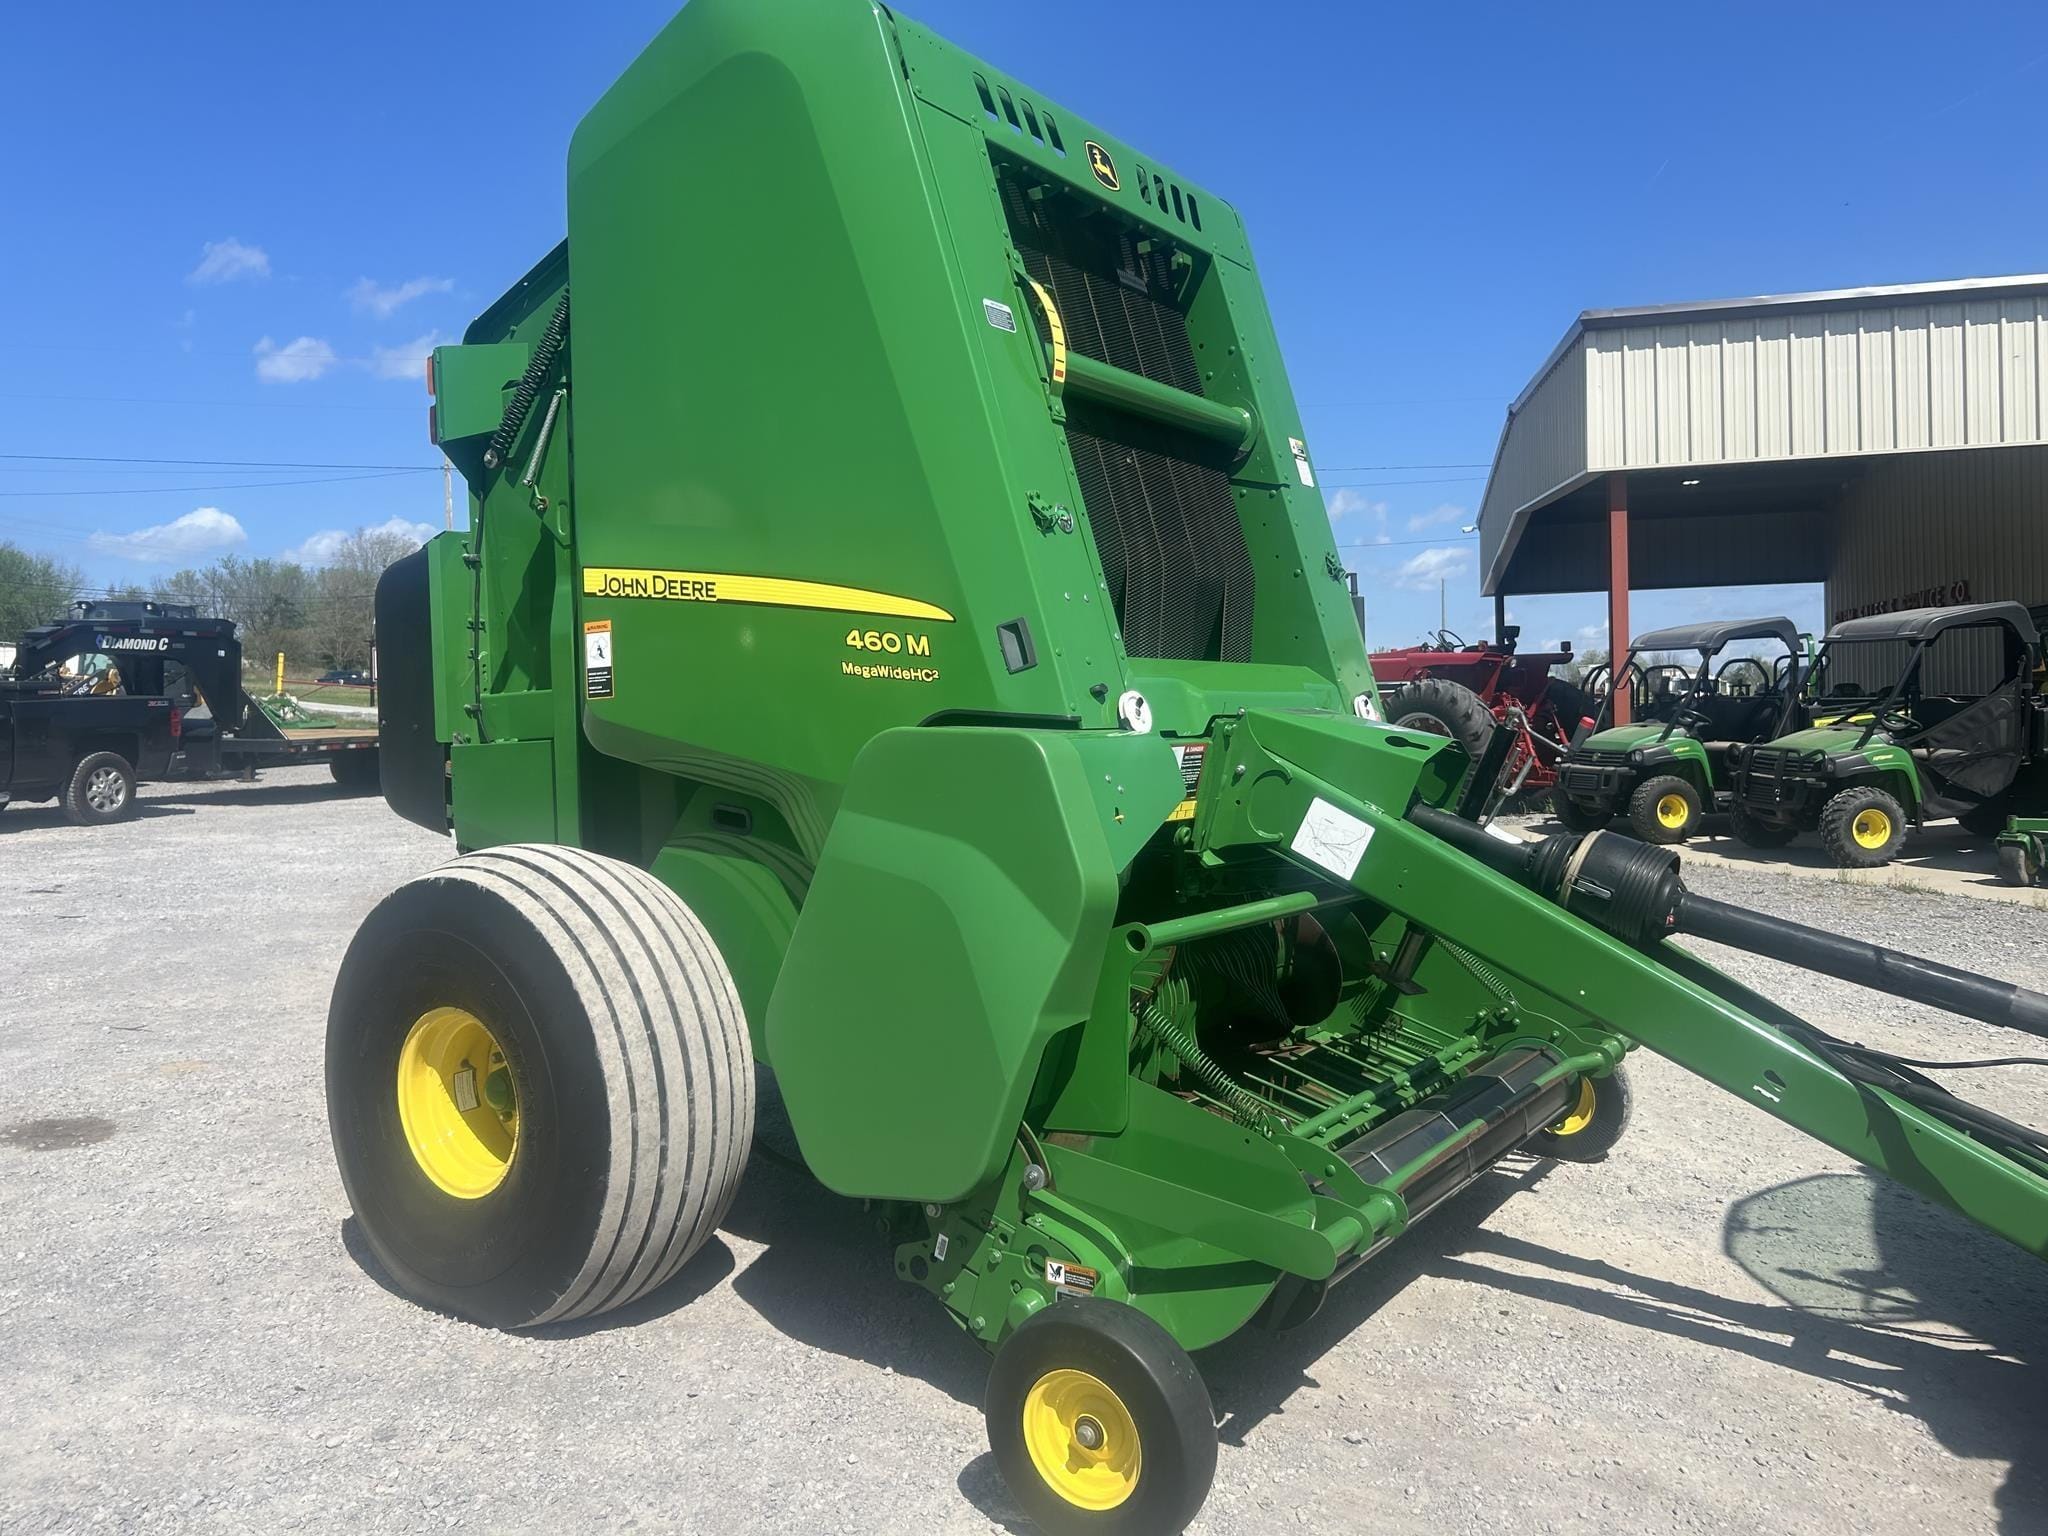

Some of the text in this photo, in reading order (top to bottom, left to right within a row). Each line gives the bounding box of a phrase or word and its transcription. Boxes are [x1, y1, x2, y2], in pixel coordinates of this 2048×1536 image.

[598, 573, 717, 598] JOHN DEERE
[101, 635, 169, 651] DIAMOND C
[846, 629, 930, 656] 460 M
